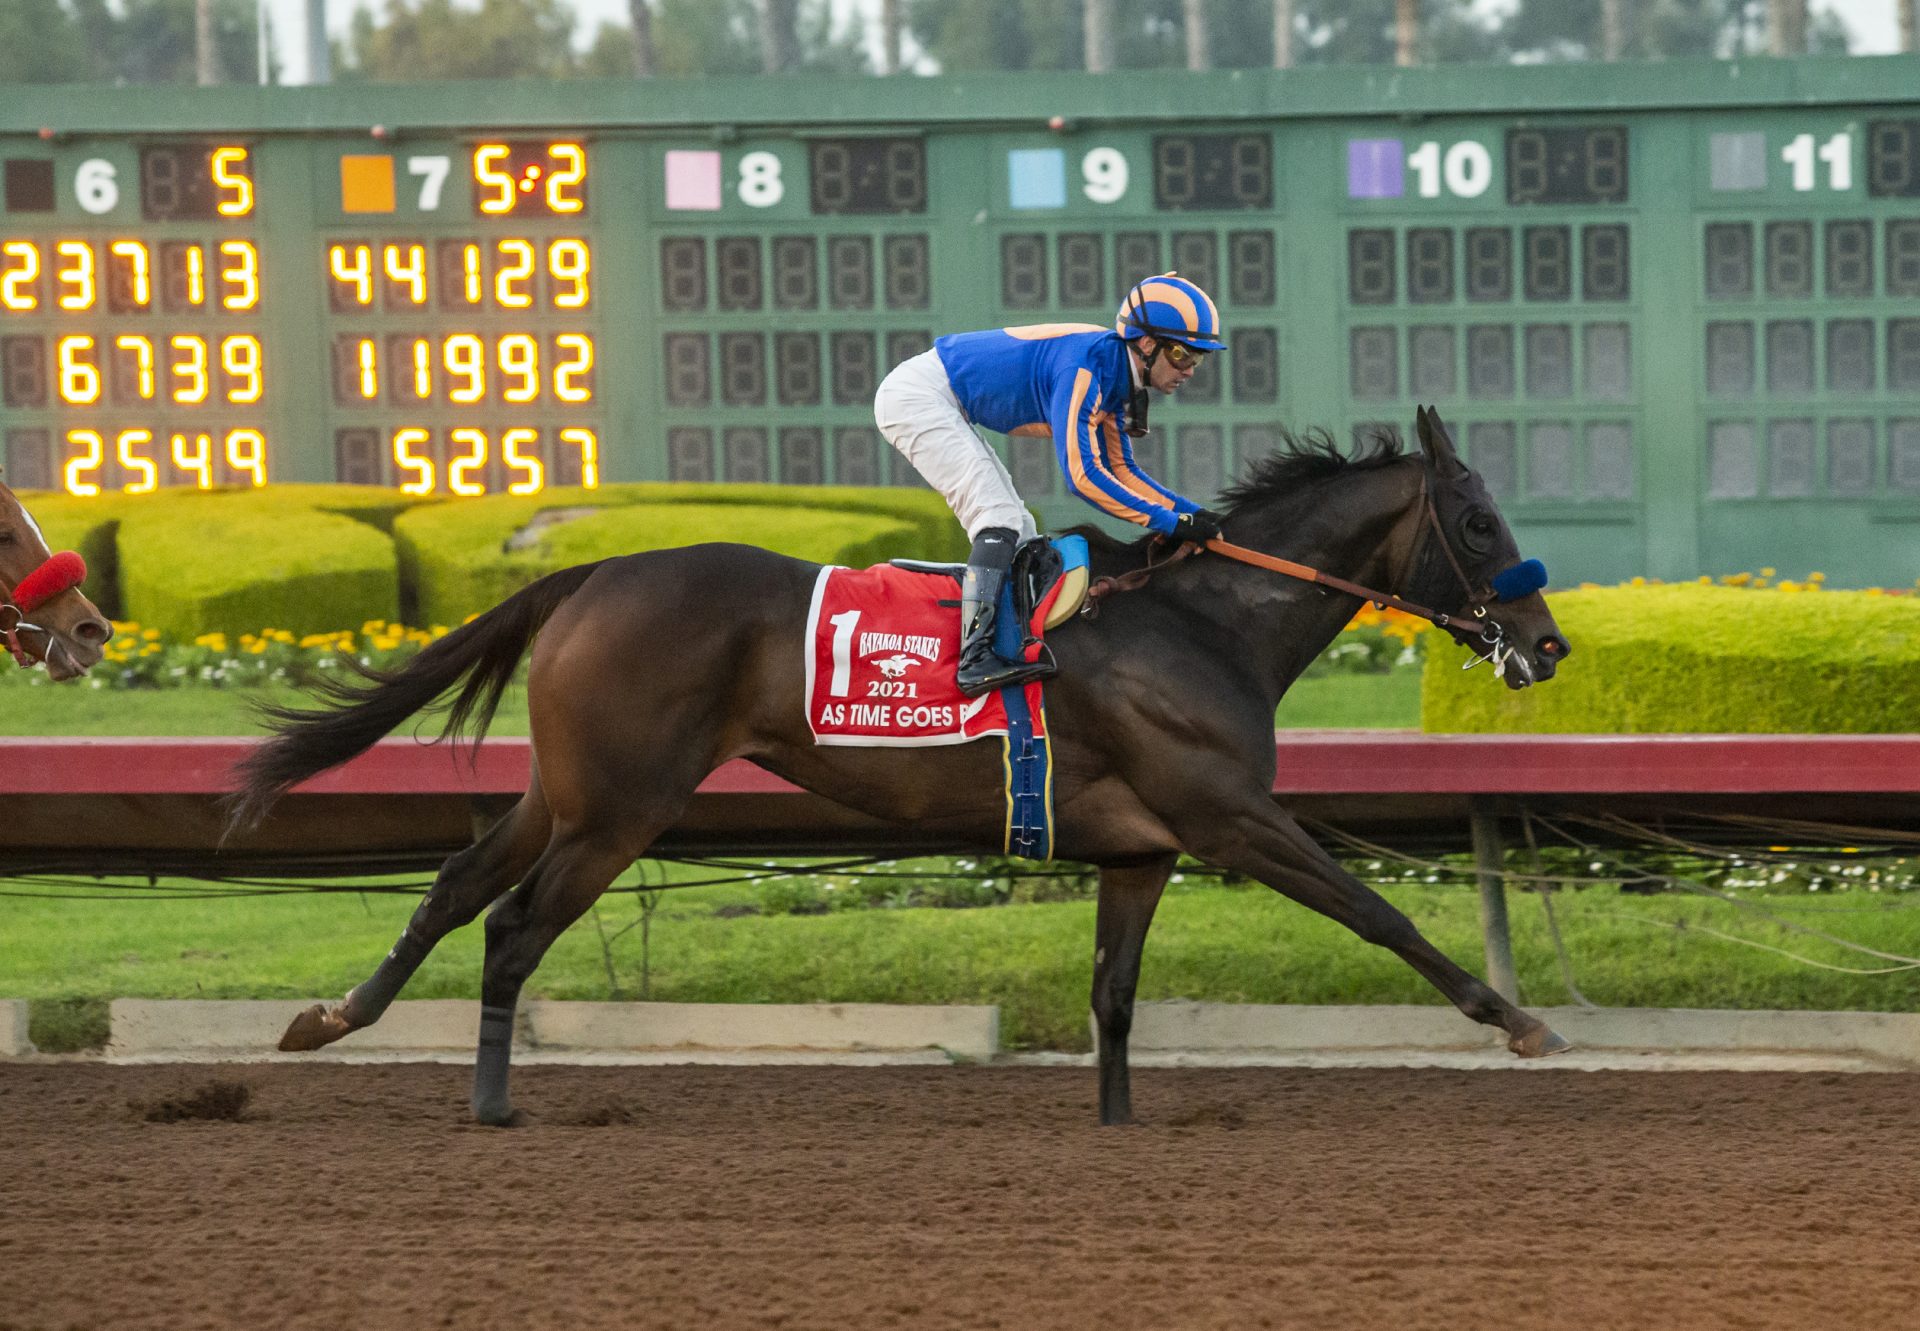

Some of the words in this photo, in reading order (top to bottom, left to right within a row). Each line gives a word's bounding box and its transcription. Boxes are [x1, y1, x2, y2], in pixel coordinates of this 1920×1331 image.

[75, 159, 118, 214] 6
[211, 147, 254, 216] 5
[408, 156, 450, 210] 7
[738, 152, 784, 207] 8
[1082, 147, 1129, 204] 9
[1408, 141, 1492, 197] 10
[1781, 133, 1853, 191] 11
[0, 240, 259, 311] 23713
[330, 239, 591, 308] 44129
[58, 335, 263, 404] 6739
[358, 333, 594, 404] 11992
[64, 429, 268, 497] 2549
[393, 428, 599, 497] 5257
[829, 610, 862, 698] 1
[859, 632, 903, 658] BAYAKOA
[903, 635, 941, 662] STAKES
[820, 704, 845, 725] AS
[850, 704, 891, 726] TIME
[895, 705, 954, 727] GOES
[866, 681, 918, 698] 2021
